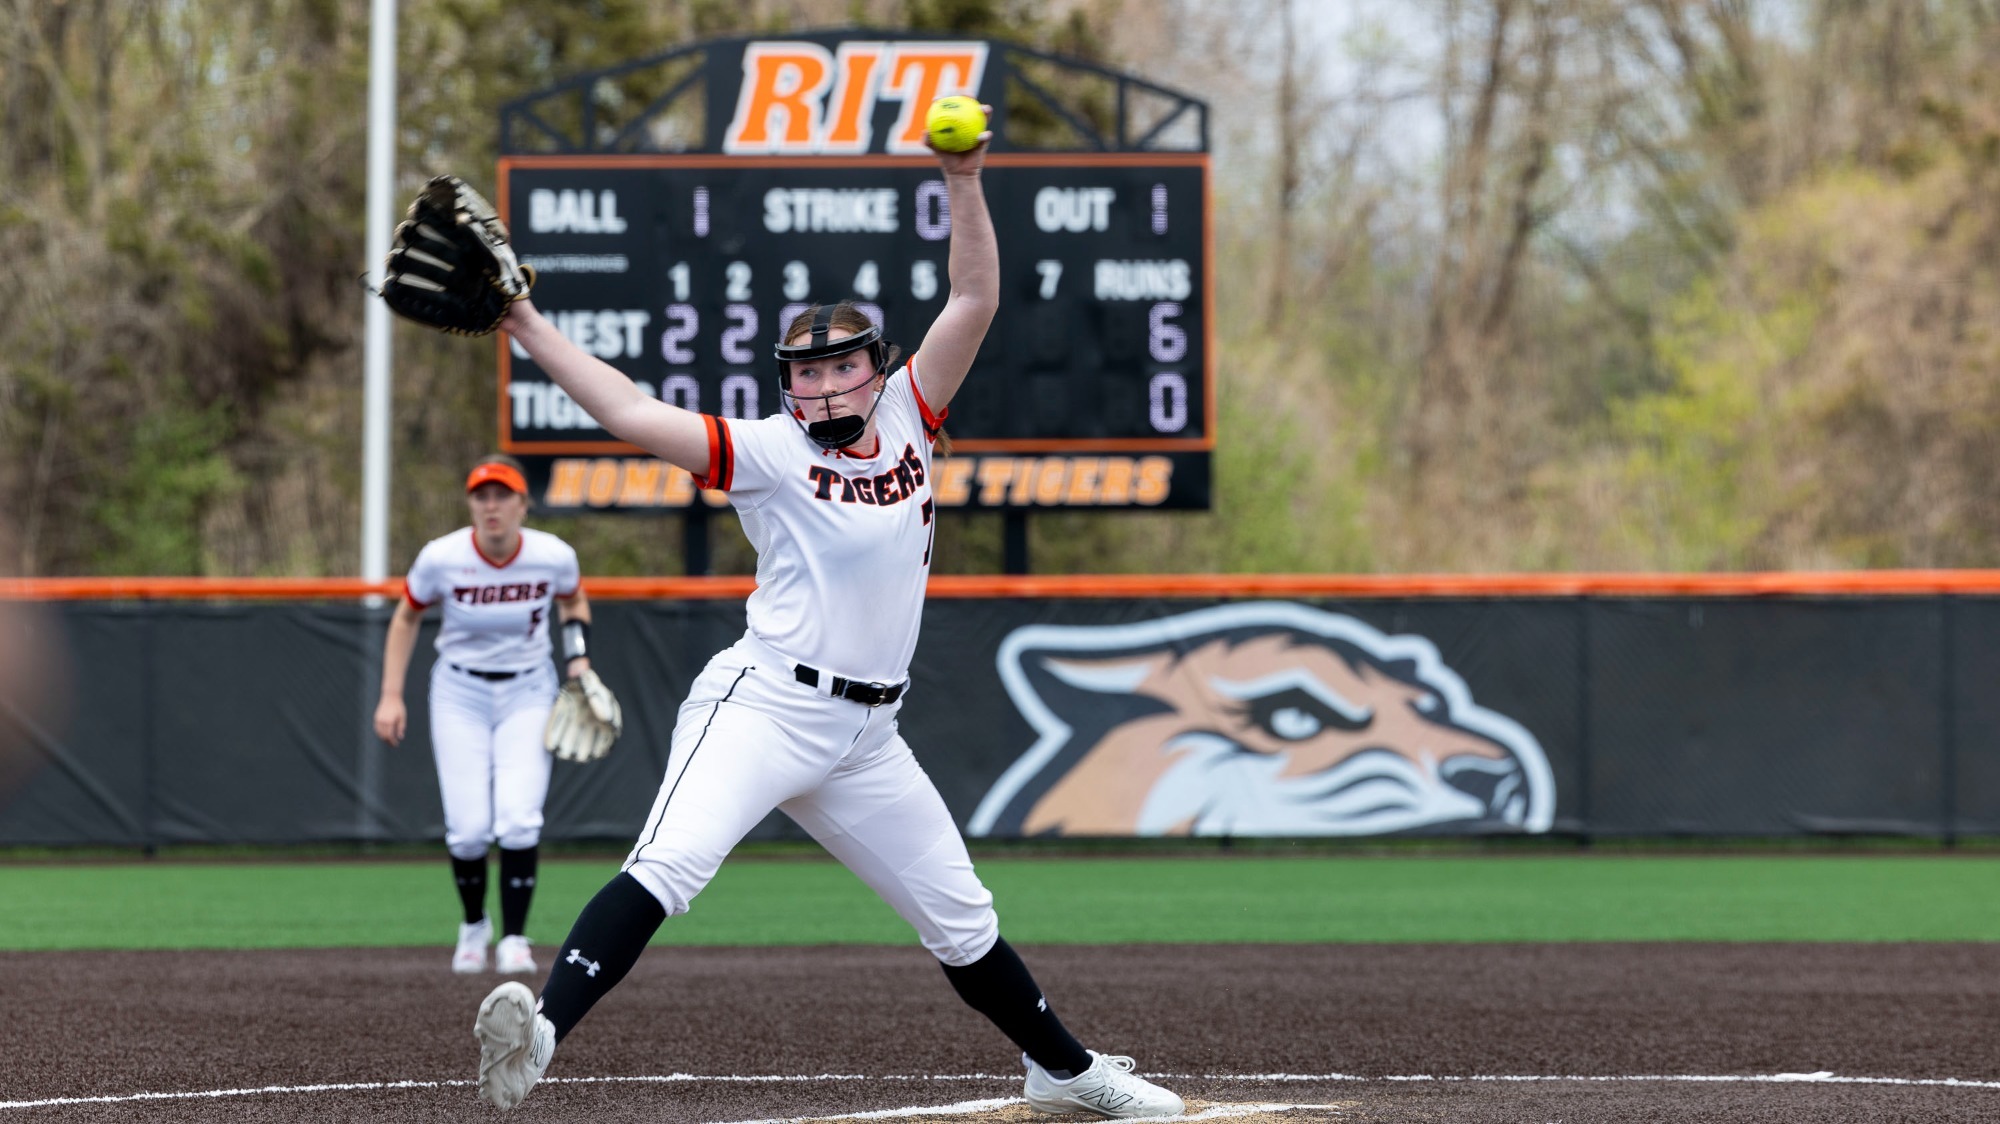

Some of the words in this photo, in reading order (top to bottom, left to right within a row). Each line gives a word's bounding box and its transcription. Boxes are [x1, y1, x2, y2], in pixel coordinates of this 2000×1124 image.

[722, 40, 990, 155] RIT
[528, 187, 628, 234] BALL
[693, 186, 710, 237] 1
[763, 187, 899, 233] STRIKE
[915, 180, 951, 240] 0
[1034, 186, 1116, 233] OUT
[1151, 183, 1168, 235] 1
[668, 261, 690, 301] 1
[726, 260, 752, 301] 2
[783, 260, 810, 300] 3
[853, 260, 881, 300] 4
[911, 260, 938, 300] 5
[1036, 260, 1063, 300] 7
[1094, 259, 1191, 301] RUNS
[661, 303, 699, 364] 2
[720, 303, 758, 364] 2
[1149, 301, 1187, 362] 6
[1150, 371, 1187, 433] 0
[544, 458, 698, 507] HOME
[977, 456, 1174, 506] TIGERS
[808, 443, 925, 507] TIGERS
[453, 581, 549, 606] TIGERS
